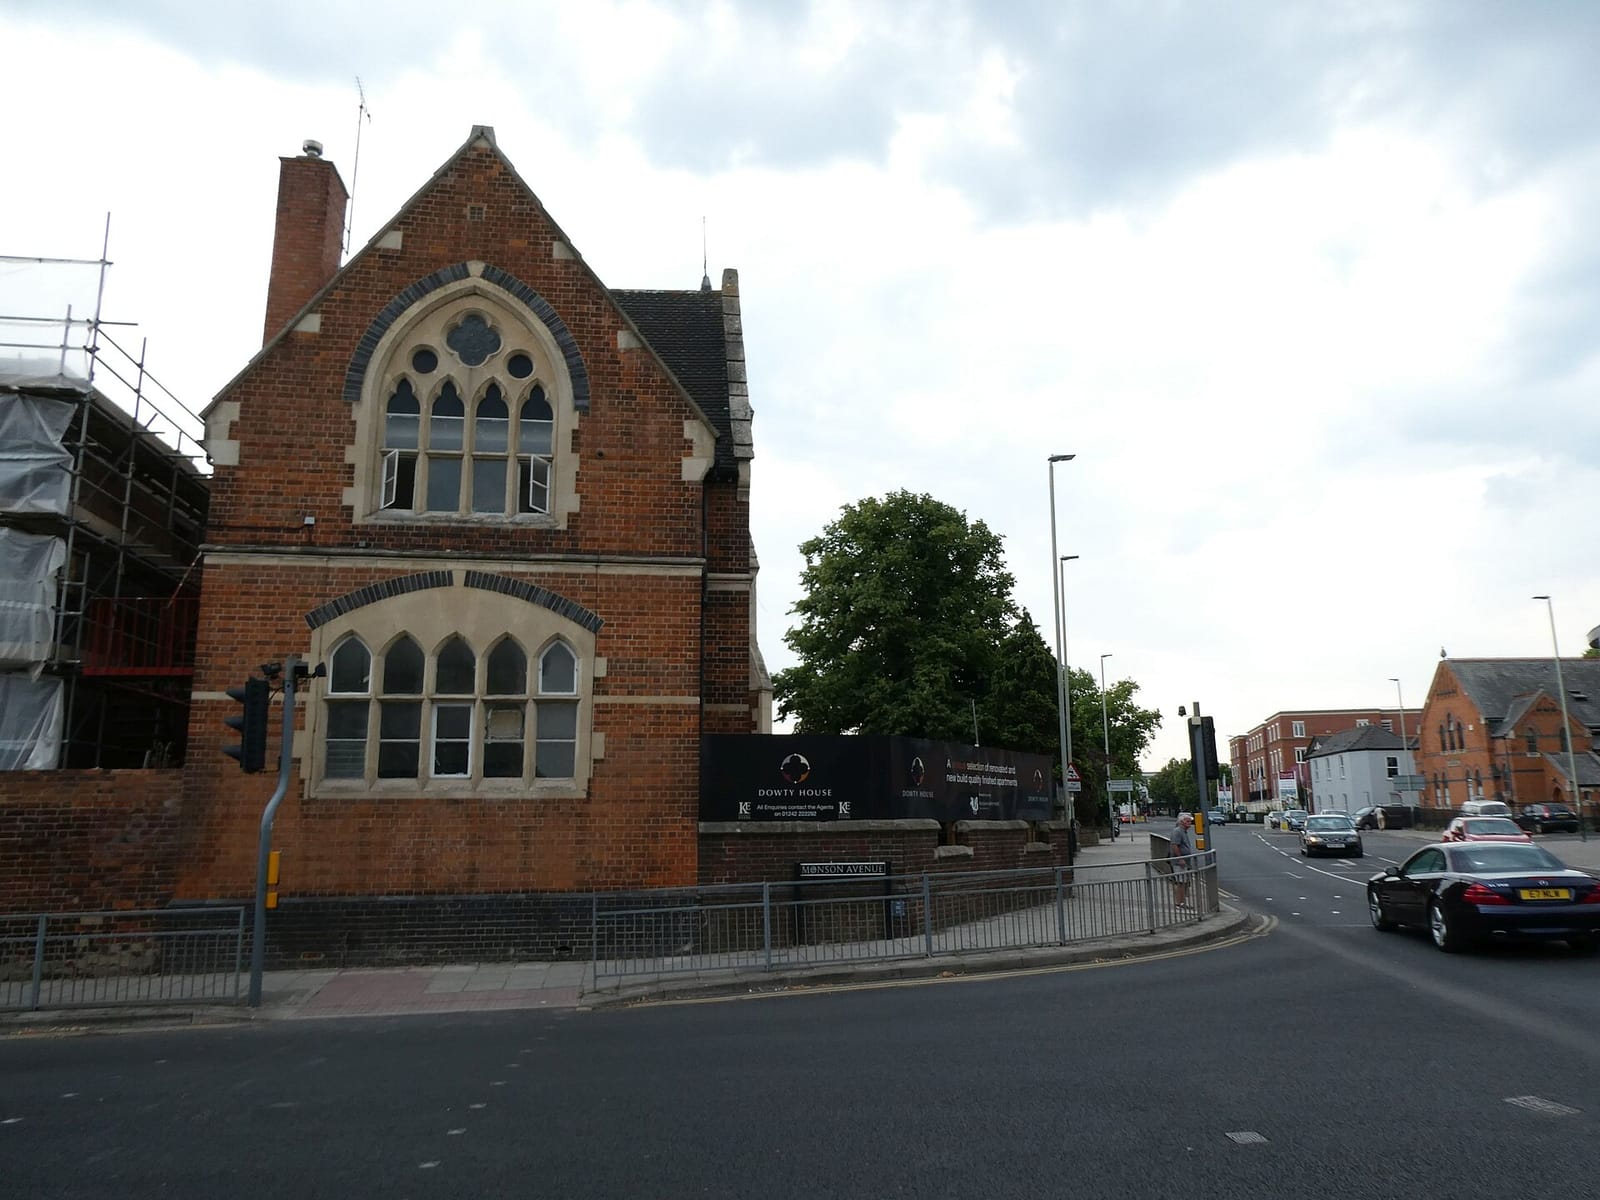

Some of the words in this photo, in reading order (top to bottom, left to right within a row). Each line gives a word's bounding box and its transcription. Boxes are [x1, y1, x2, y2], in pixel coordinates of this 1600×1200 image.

[758, 789, 794, 797] DOWTY
[799, 789, 832, 797] HOUSE
[801, 865, 844, 874] MONSON
[846, 864, 884, 873] AVENUE
